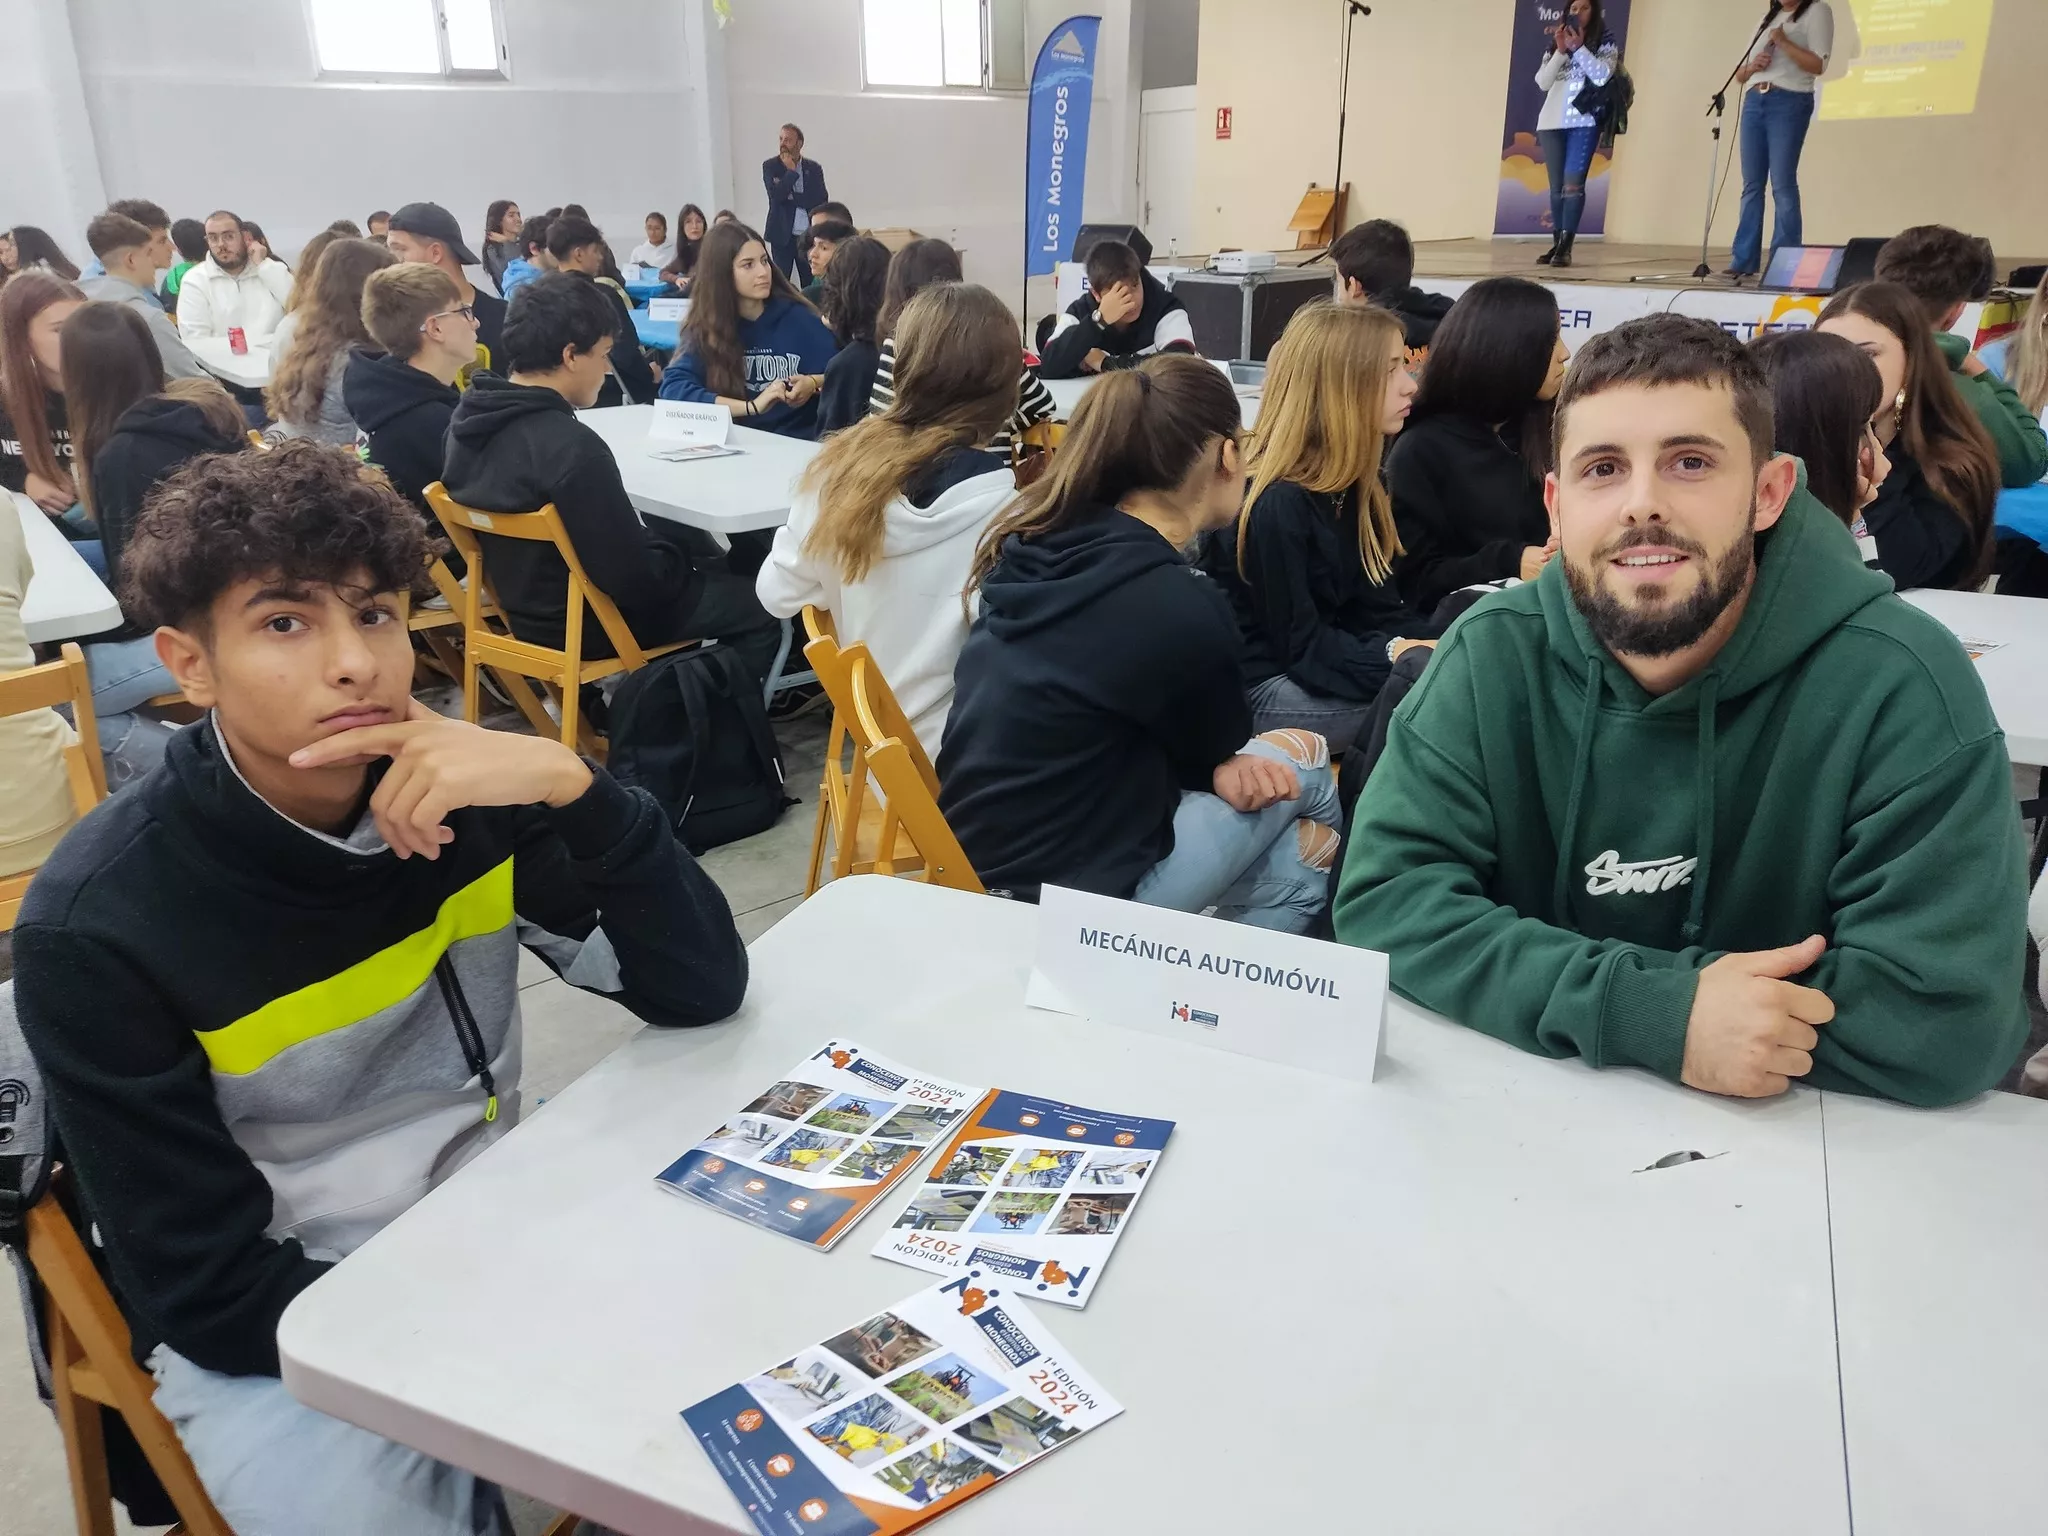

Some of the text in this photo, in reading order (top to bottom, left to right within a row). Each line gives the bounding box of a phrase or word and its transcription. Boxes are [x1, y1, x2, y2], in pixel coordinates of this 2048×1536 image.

[1043, 86, 1069, 252] Los Monegros
[1079, 927, 1340, 1000] MECÁNICA AUTOMÓVIL
[857, 1070, 898, 1091] MONEGROS
[923, 1081, 966, 1099] EDICIÓN
[906, 1086, 953, 1105] 2024
[893, 1243, 946, 1264] EDICIÓN
[907, 1233, 962, 1256] 2024
[977, 1249, 1028, 1266] MONEGROS
[983, 1323, 1022, 1364] MONEGROS
[1029, 1369, 1079, 1414] 2024
[1053, 1367, 1098, 1410] EDICIÓN
